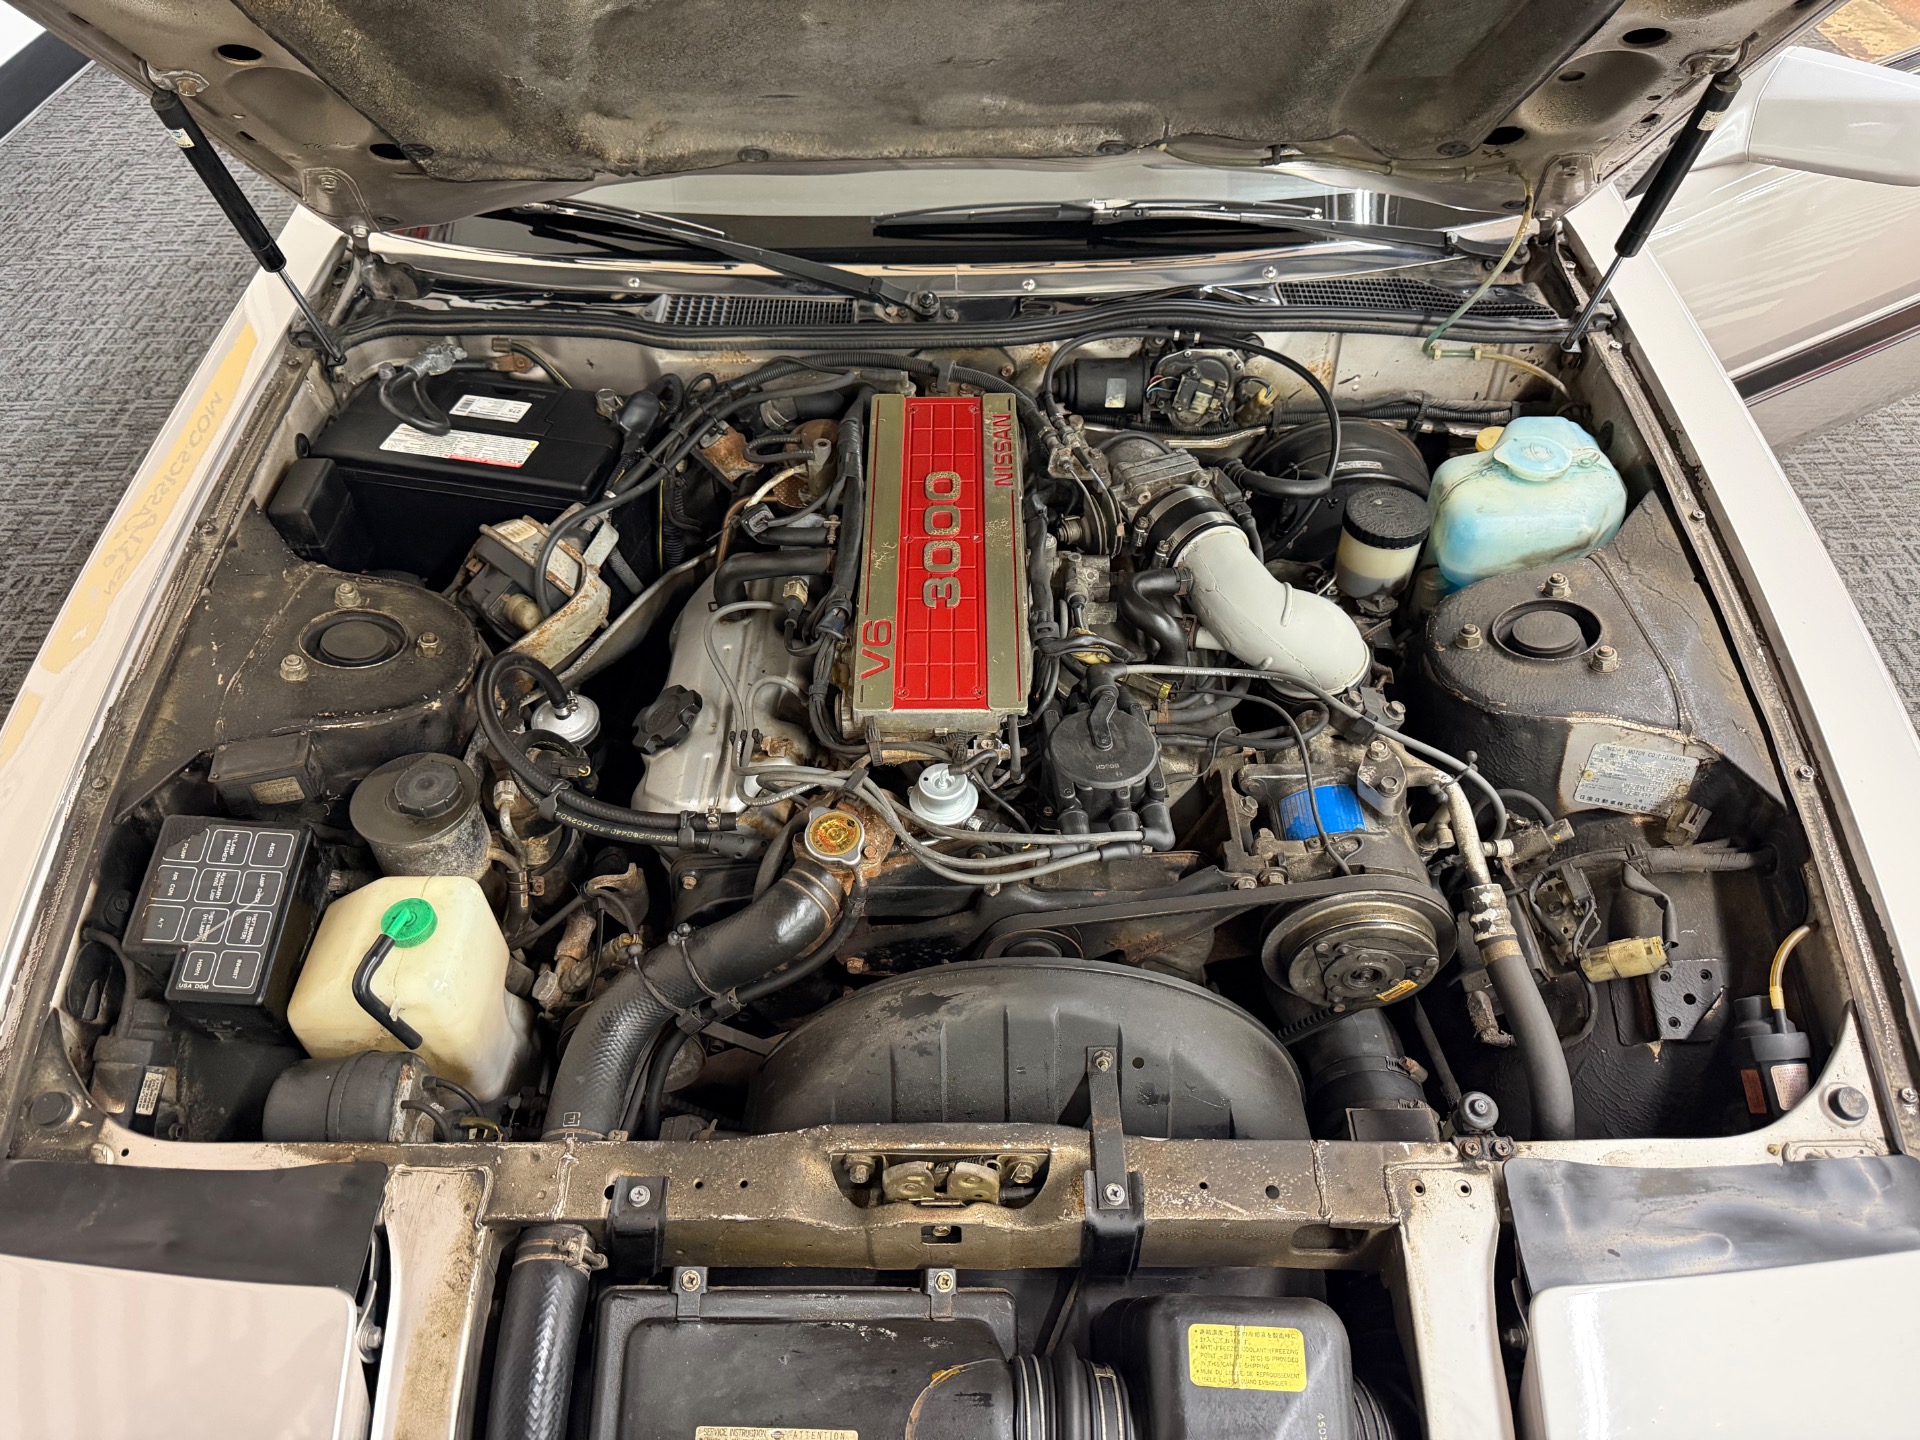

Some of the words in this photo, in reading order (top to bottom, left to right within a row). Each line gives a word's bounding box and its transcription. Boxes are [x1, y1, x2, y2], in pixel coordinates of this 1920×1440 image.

[993, 413, 1013, 486] NISSAN
[923, 471, 961, 608] 3000
[861, 620, 891, 679] V6
[180, 843, 188, 859] PUMP
[221, 840, 231, 862] WASHER
[267, 843, 276, 858] ASCD
[167, 883, 176, 896] CON
[704, 1428, 727, 1436] SERVICE
[793, 1431, 845, 1440] ATTENTION
